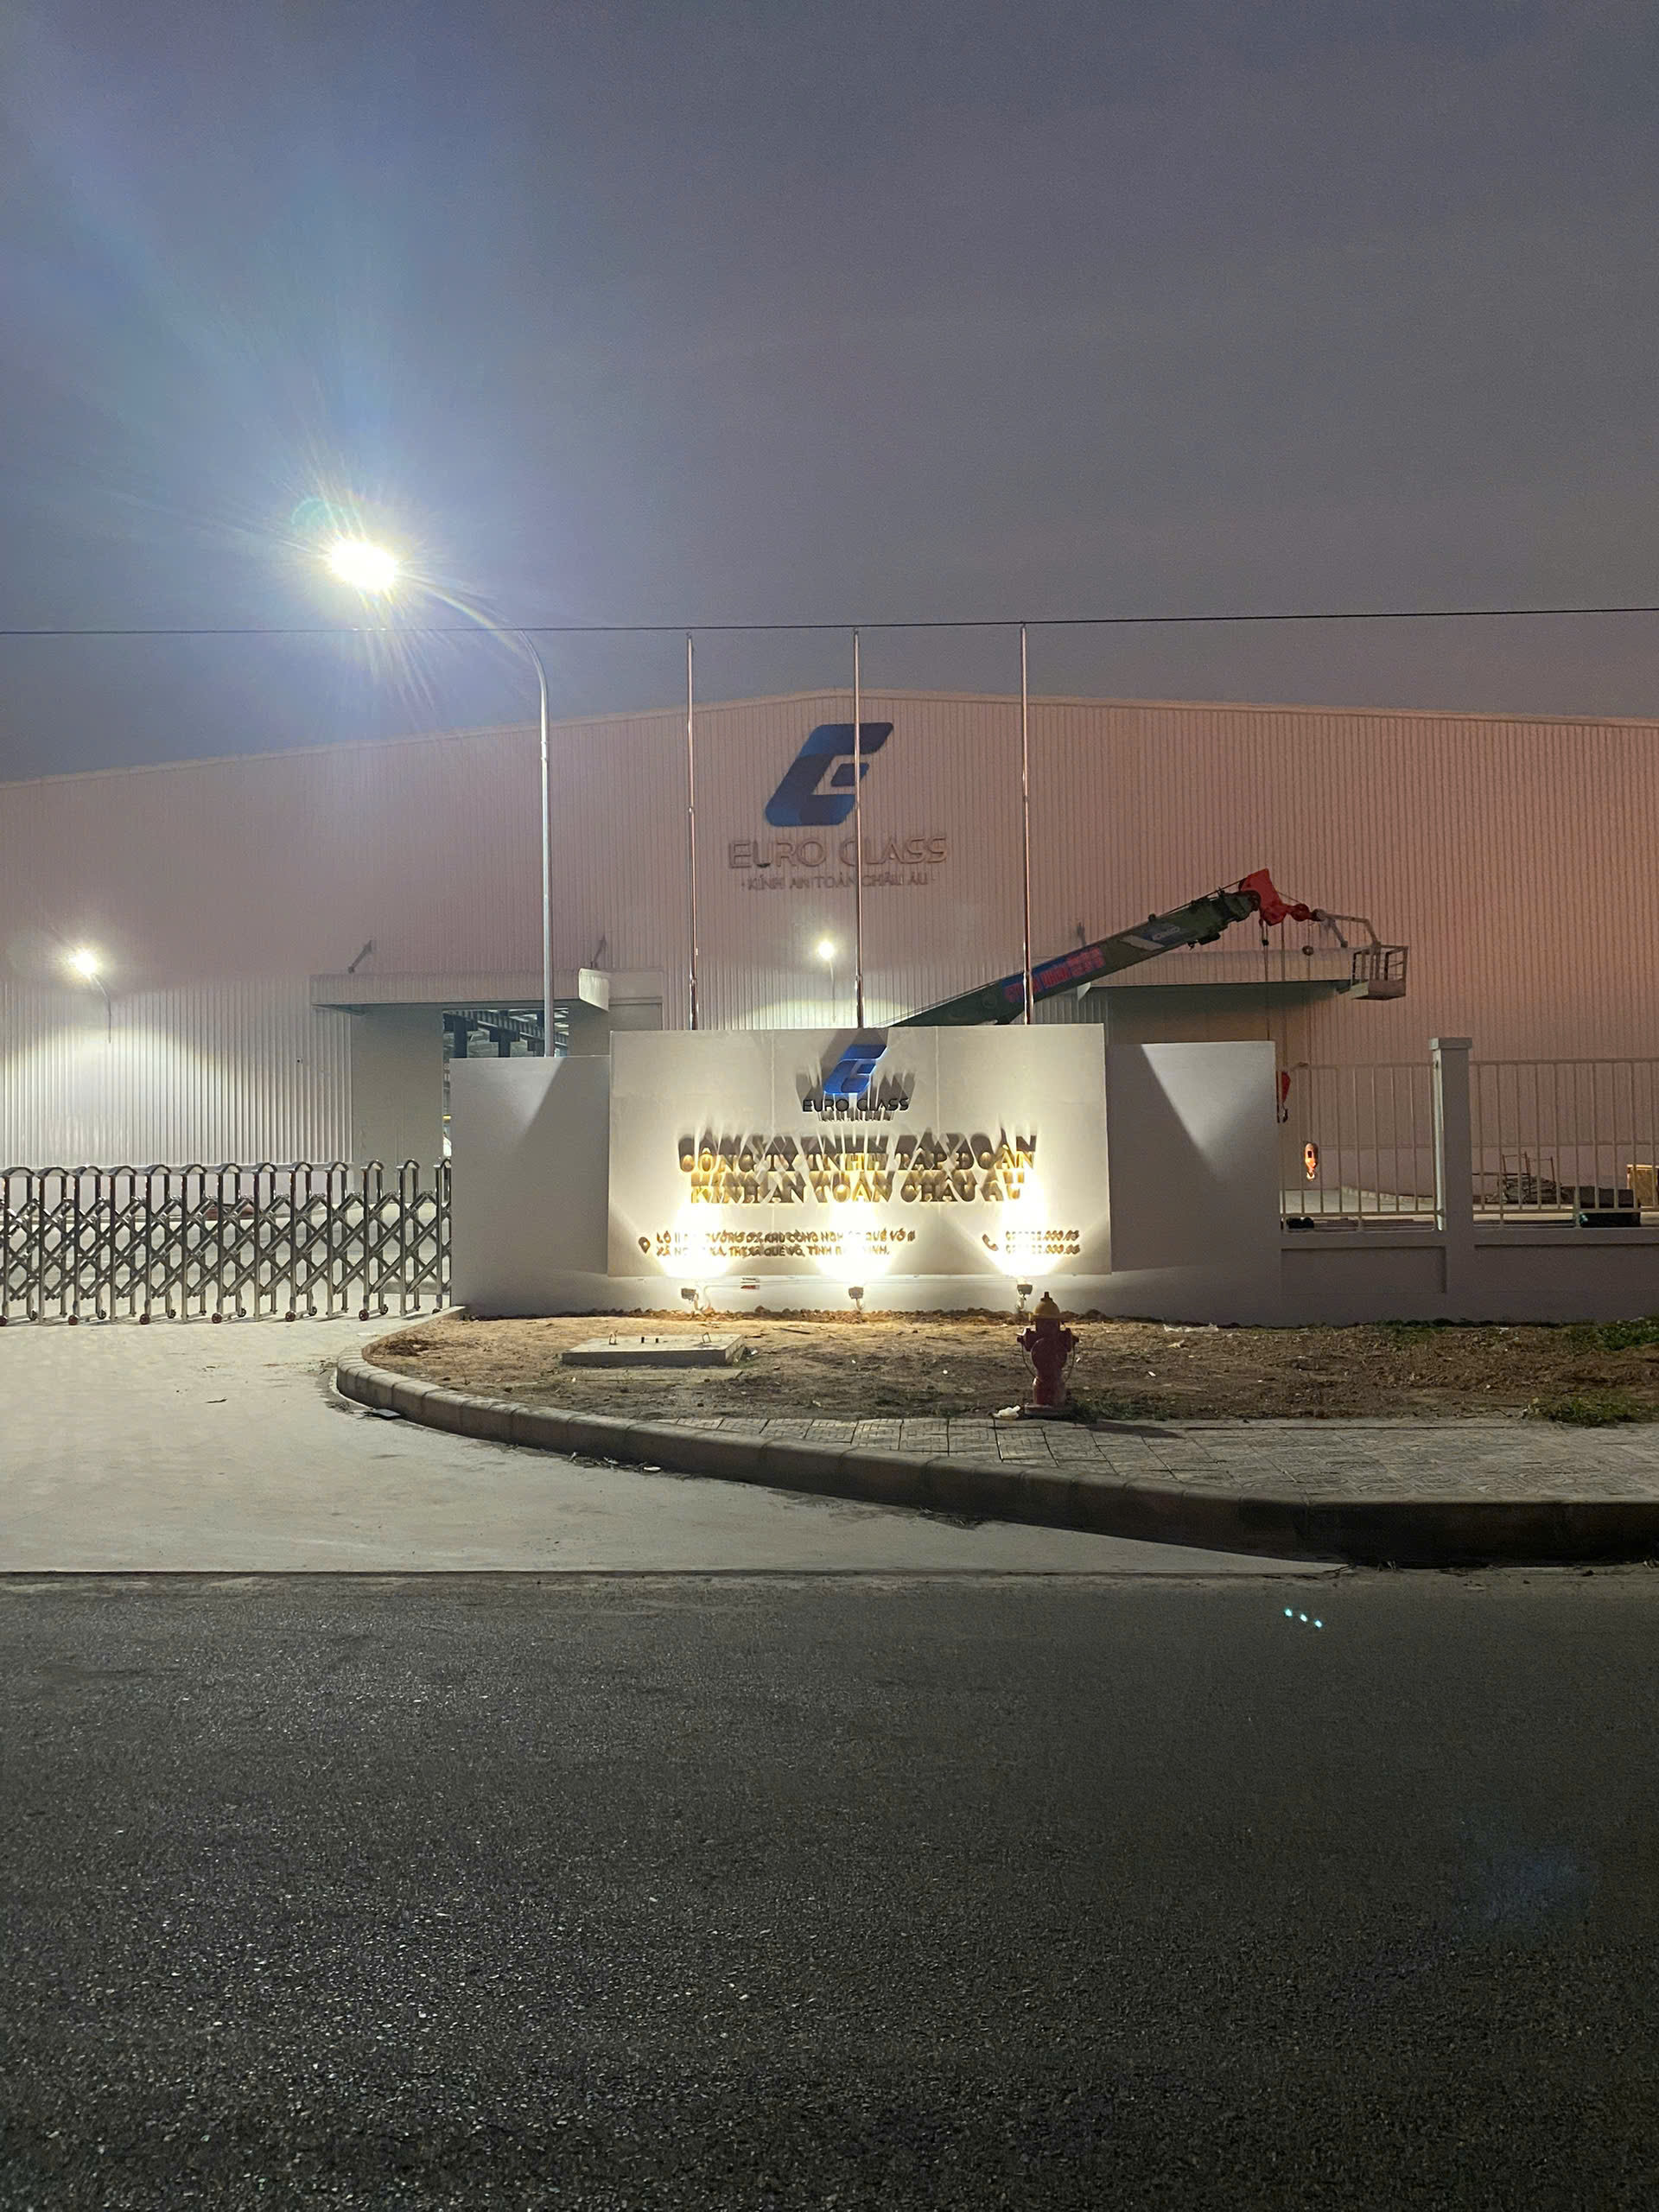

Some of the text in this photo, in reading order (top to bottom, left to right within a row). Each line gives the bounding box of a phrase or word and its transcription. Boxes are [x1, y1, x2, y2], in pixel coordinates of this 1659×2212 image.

[728, 838, 827, 868] EURO
[802, 1098, 849, 1112] EURO
[678, 1146, 757, 1173] CÔNG
